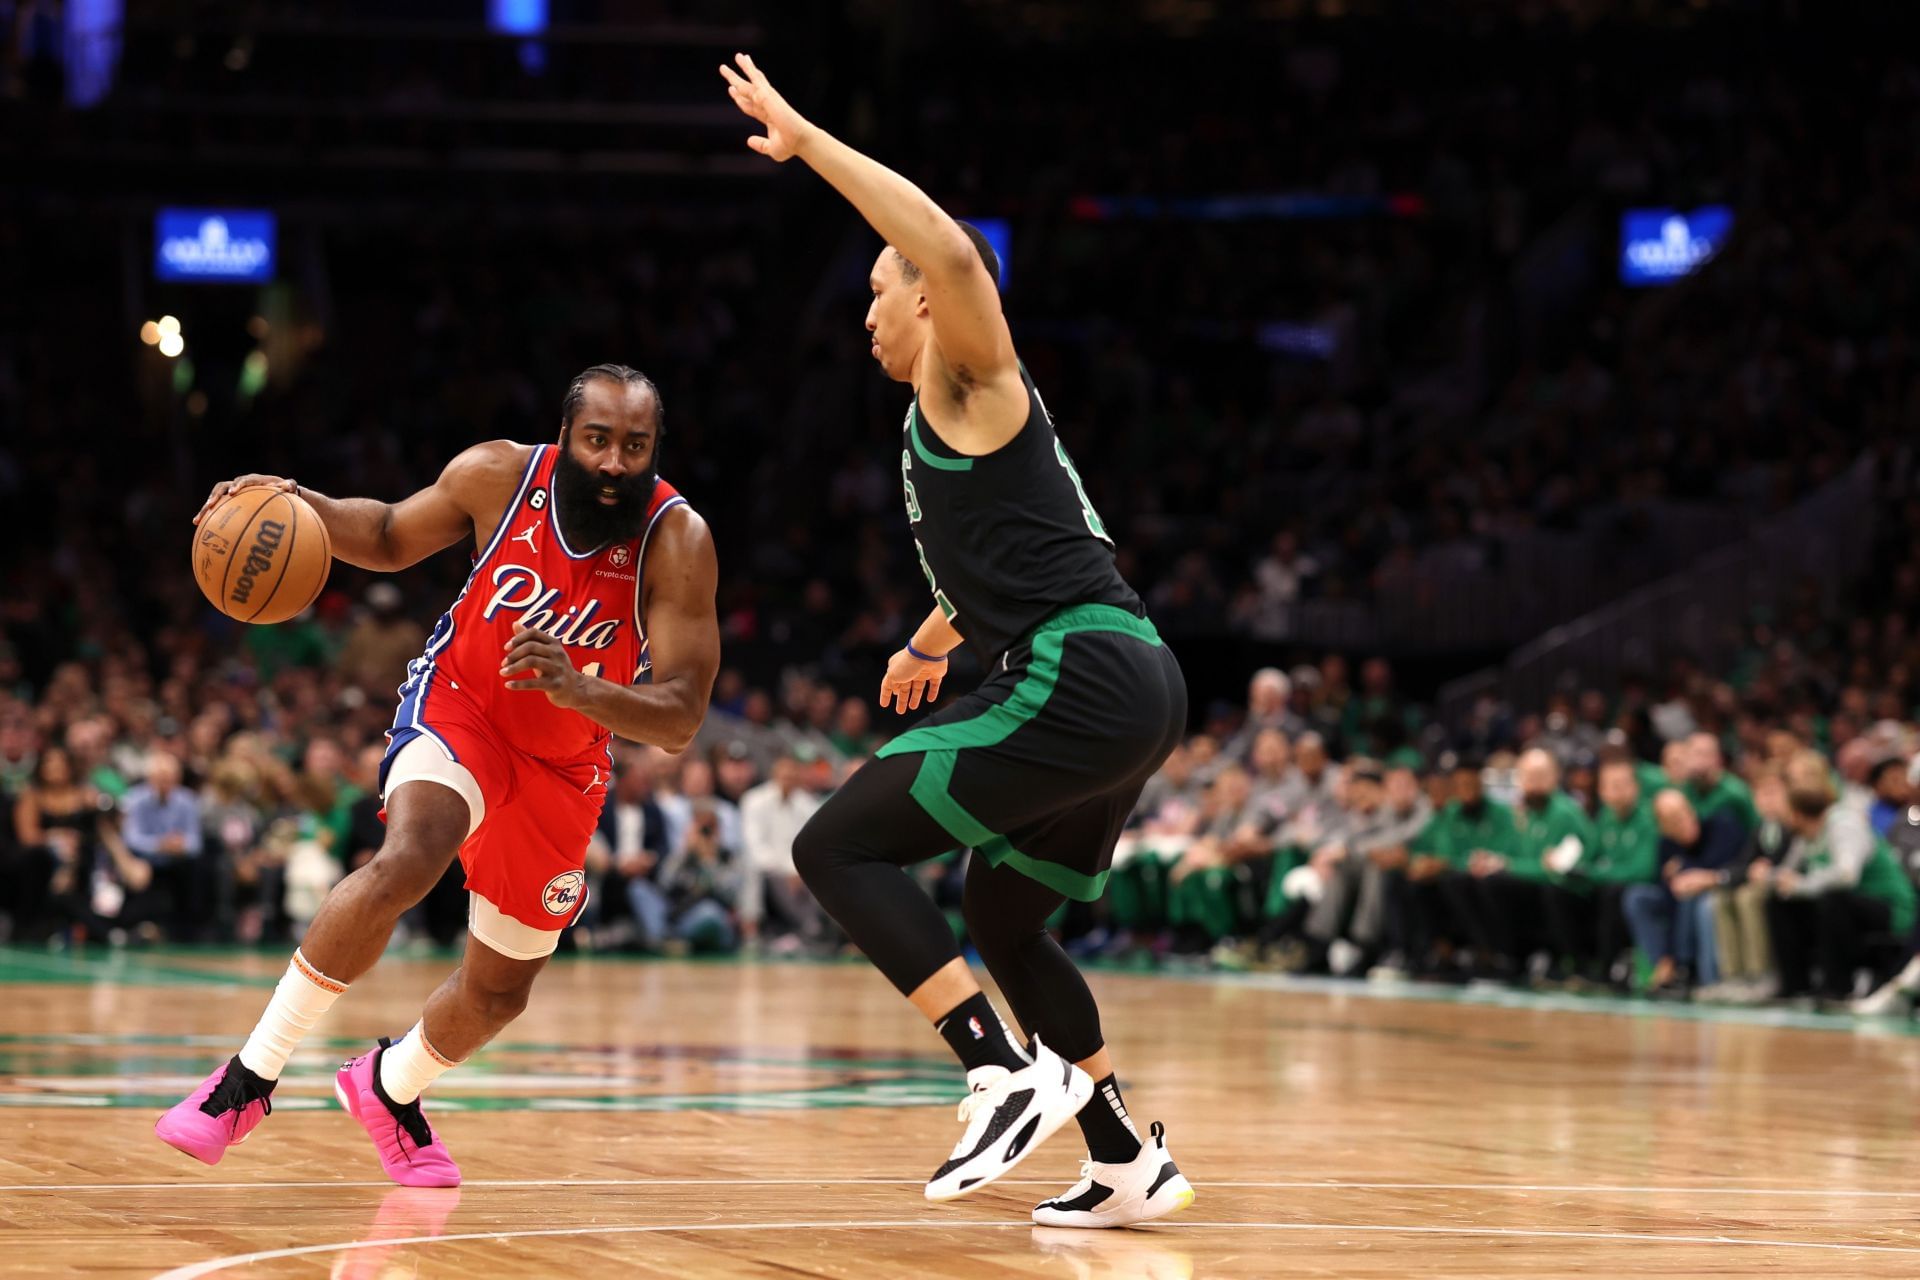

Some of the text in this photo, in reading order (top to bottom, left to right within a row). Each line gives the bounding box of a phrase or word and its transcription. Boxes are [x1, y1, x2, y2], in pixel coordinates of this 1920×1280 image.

[530, 489, 547, 509] 6
[231, 519, 286, 604] Wilson
[595, 569, 636, 582] crypto.com
[483, 564, 625, 651] Phila
